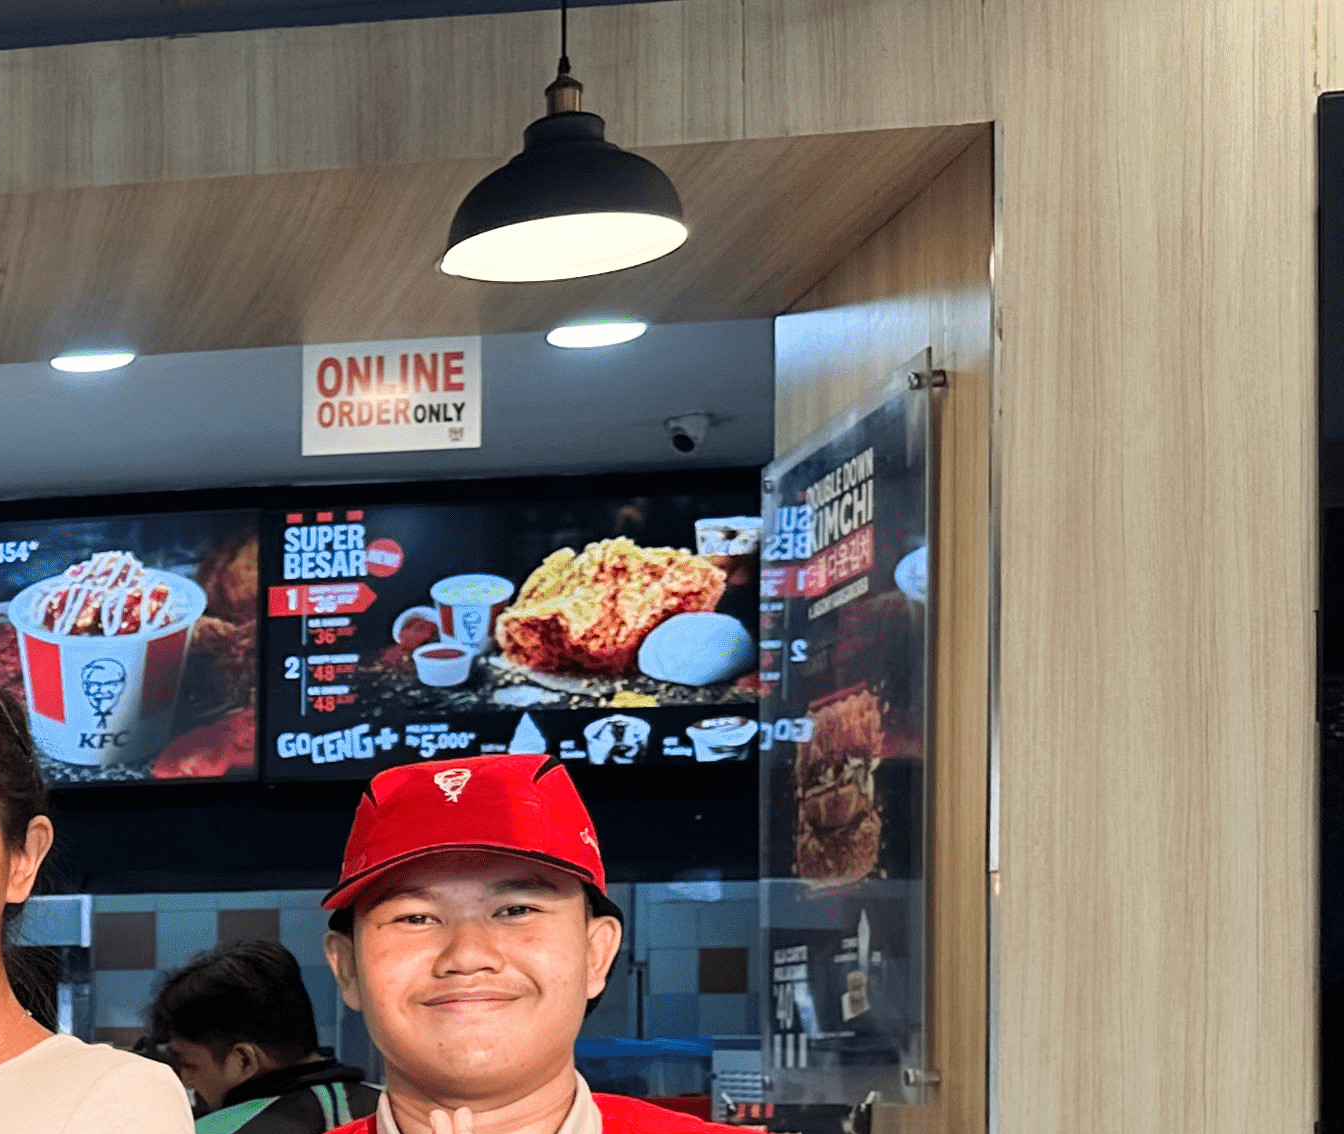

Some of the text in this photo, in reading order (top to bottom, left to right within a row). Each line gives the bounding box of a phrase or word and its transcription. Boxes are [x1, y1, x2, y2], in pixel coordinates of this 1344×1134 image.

[316, 351, 465, 399] ONLINE
[317, 399, 465, 429] ORDER ONLY
[843, 447, 874, 491] DOWN
[811, 479, 874, 553] KIMCHI
[284, 524, 365, 552] SUPER
[284, 550, 367, 579] BESAR
[286, 588, 298, 610] 1
[284, 656, 300, 679] 2
[78, 730, 130, 750] KFC
